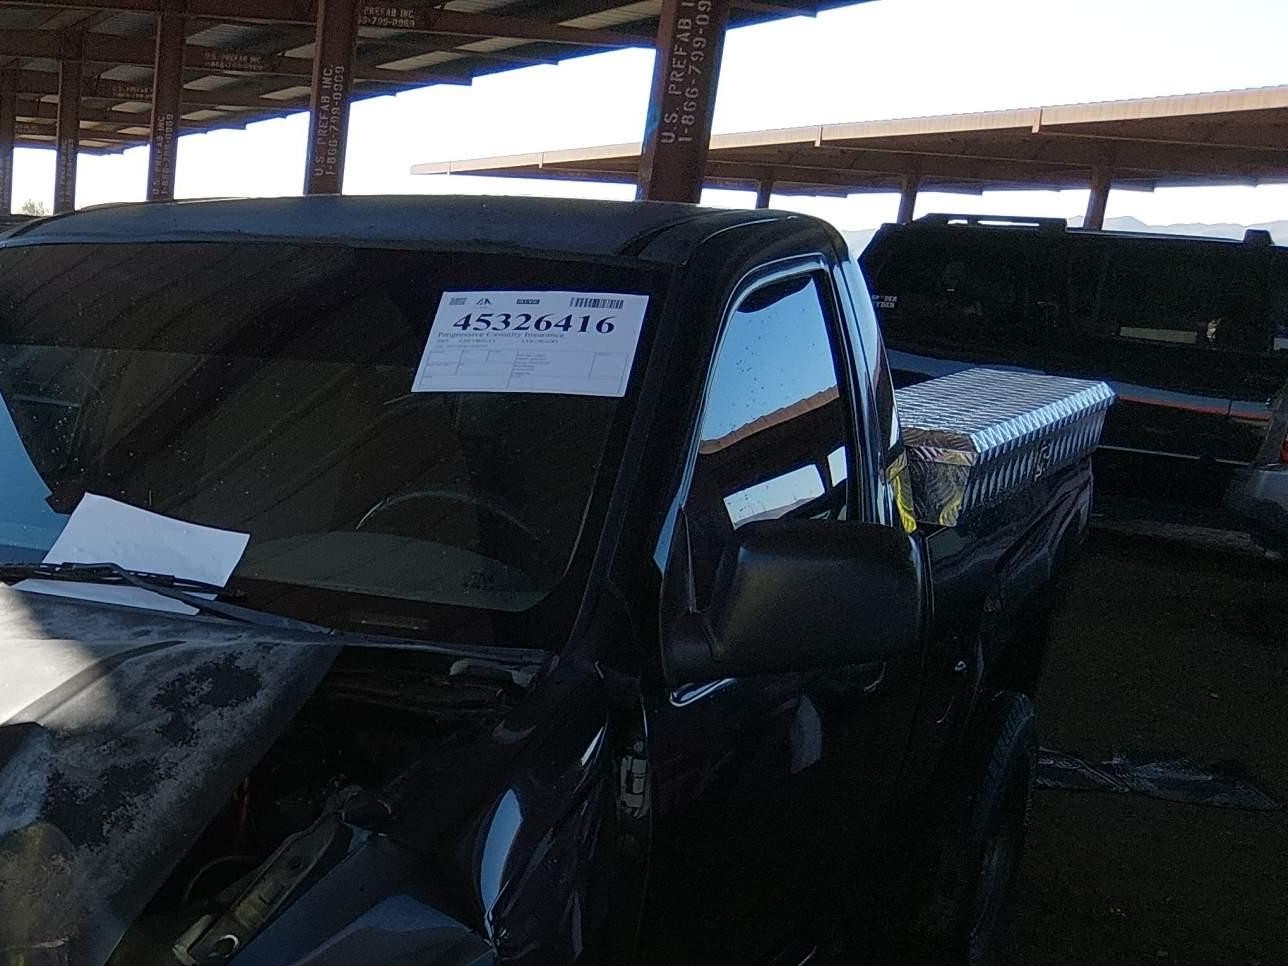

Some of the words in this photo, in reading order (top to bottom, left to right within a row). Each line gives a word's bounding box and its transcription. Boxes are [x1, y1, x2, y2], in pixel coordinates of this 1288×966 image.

[668, 19, 691, 95] PREFAB
[678, 0, 712, 142] 1-866-799-09
[453, 312, 616, 334] 45326416
